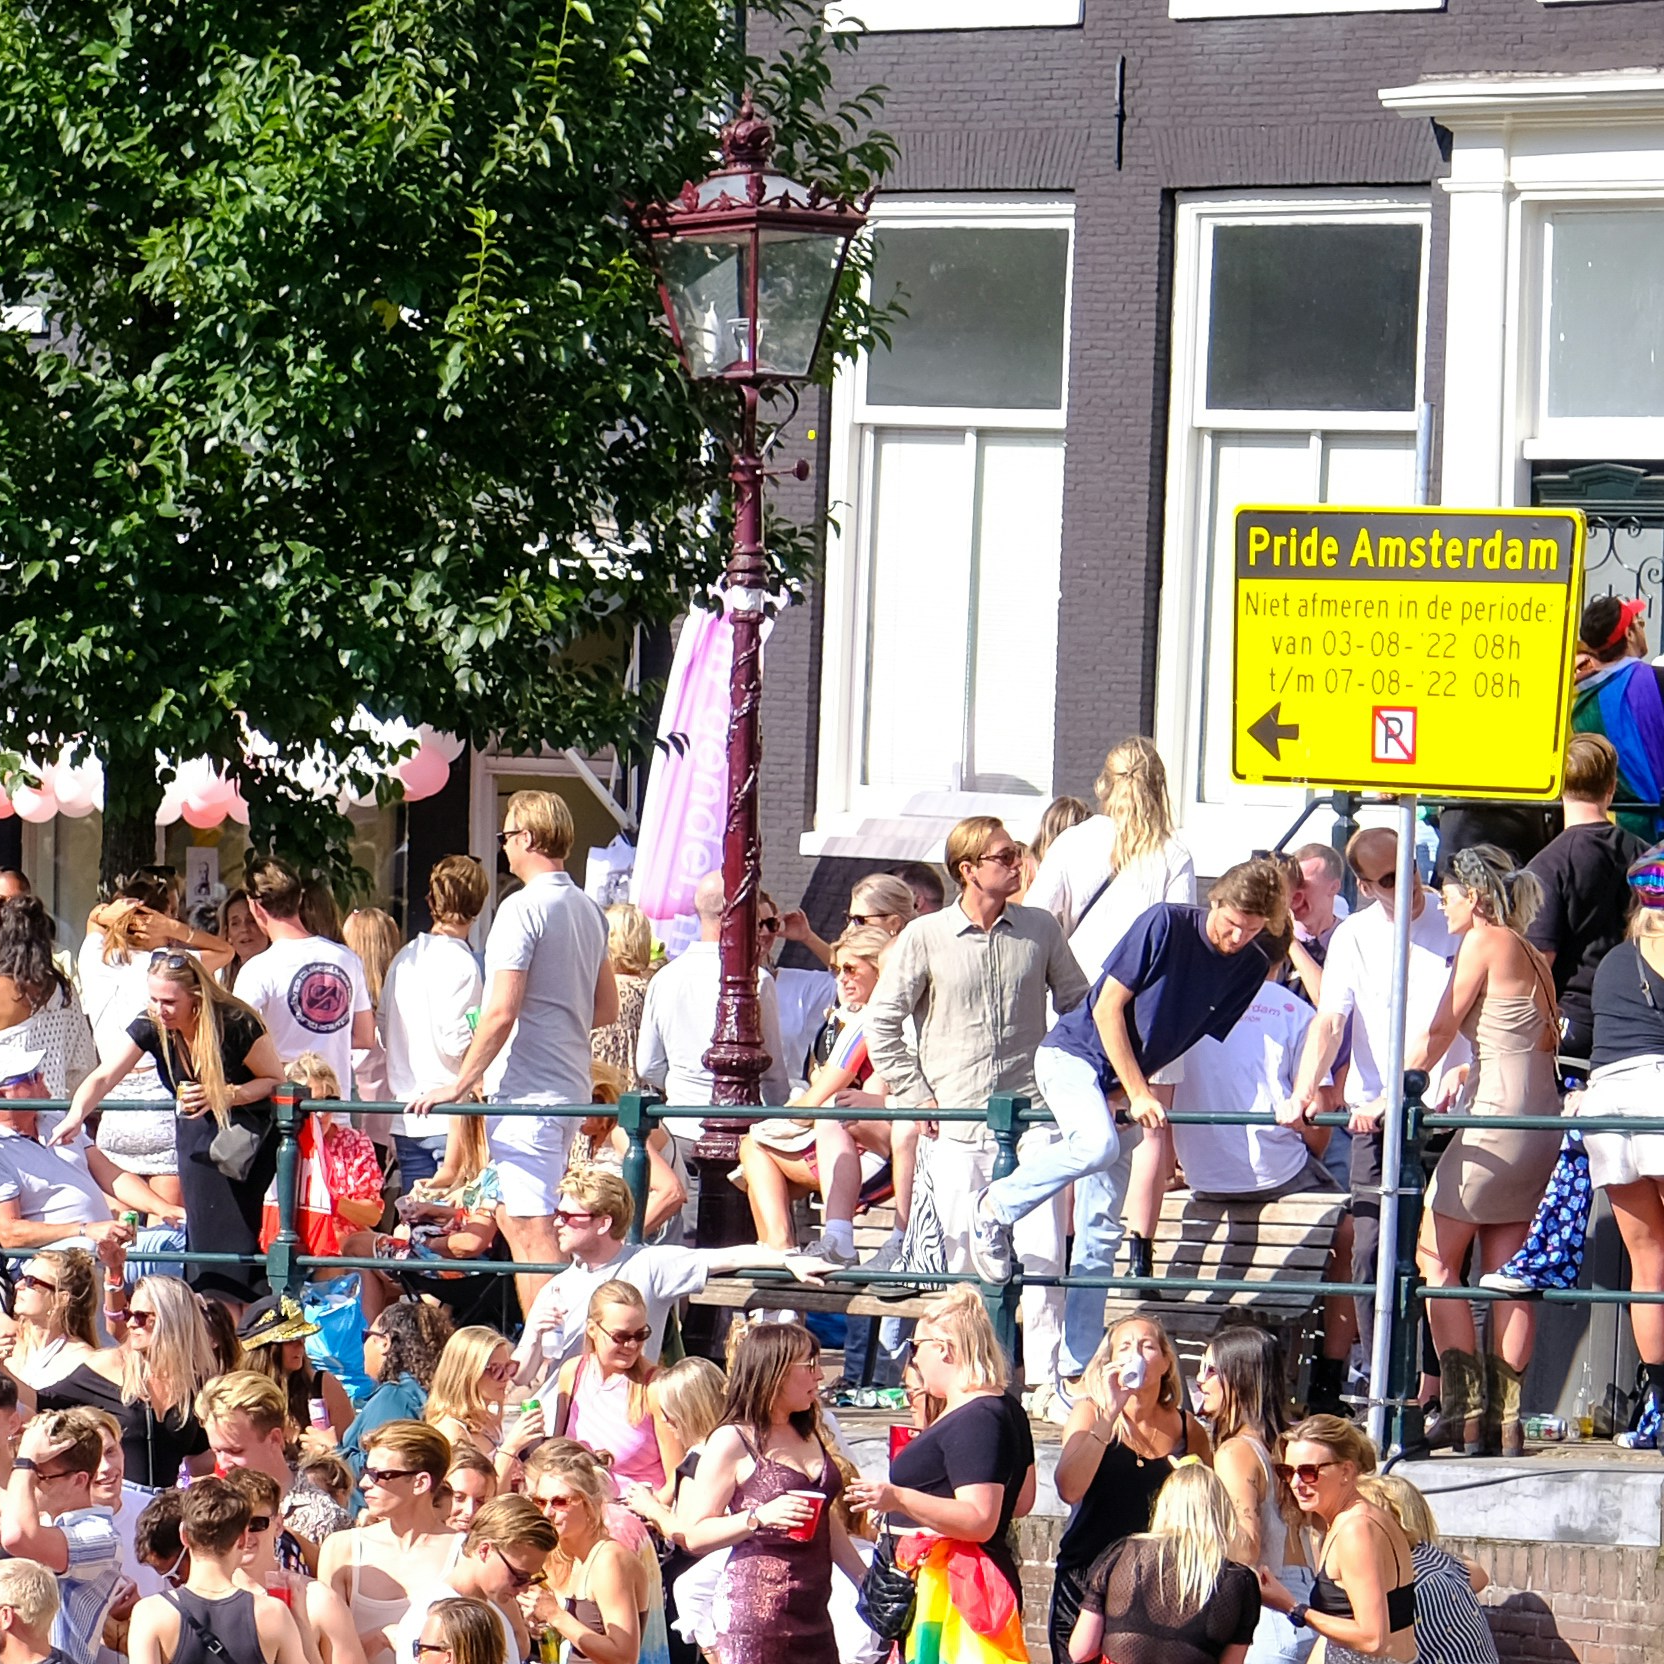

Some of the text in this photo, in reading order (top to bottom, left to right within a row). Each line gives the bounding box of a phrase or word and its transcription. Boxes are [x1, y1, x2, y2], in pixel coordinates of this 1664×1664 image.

[1248, 527, 1558, 571] Pride Amsterdam
[1245, 591, 1554, 626] Niet afmeren in de periode:
[1272, 635, 1312, 656] van
[1474, 634, 1520, 660] 08h
[1269, 666, 1314, 694] t/m
[1474, 671, 1520, 699] 08h
